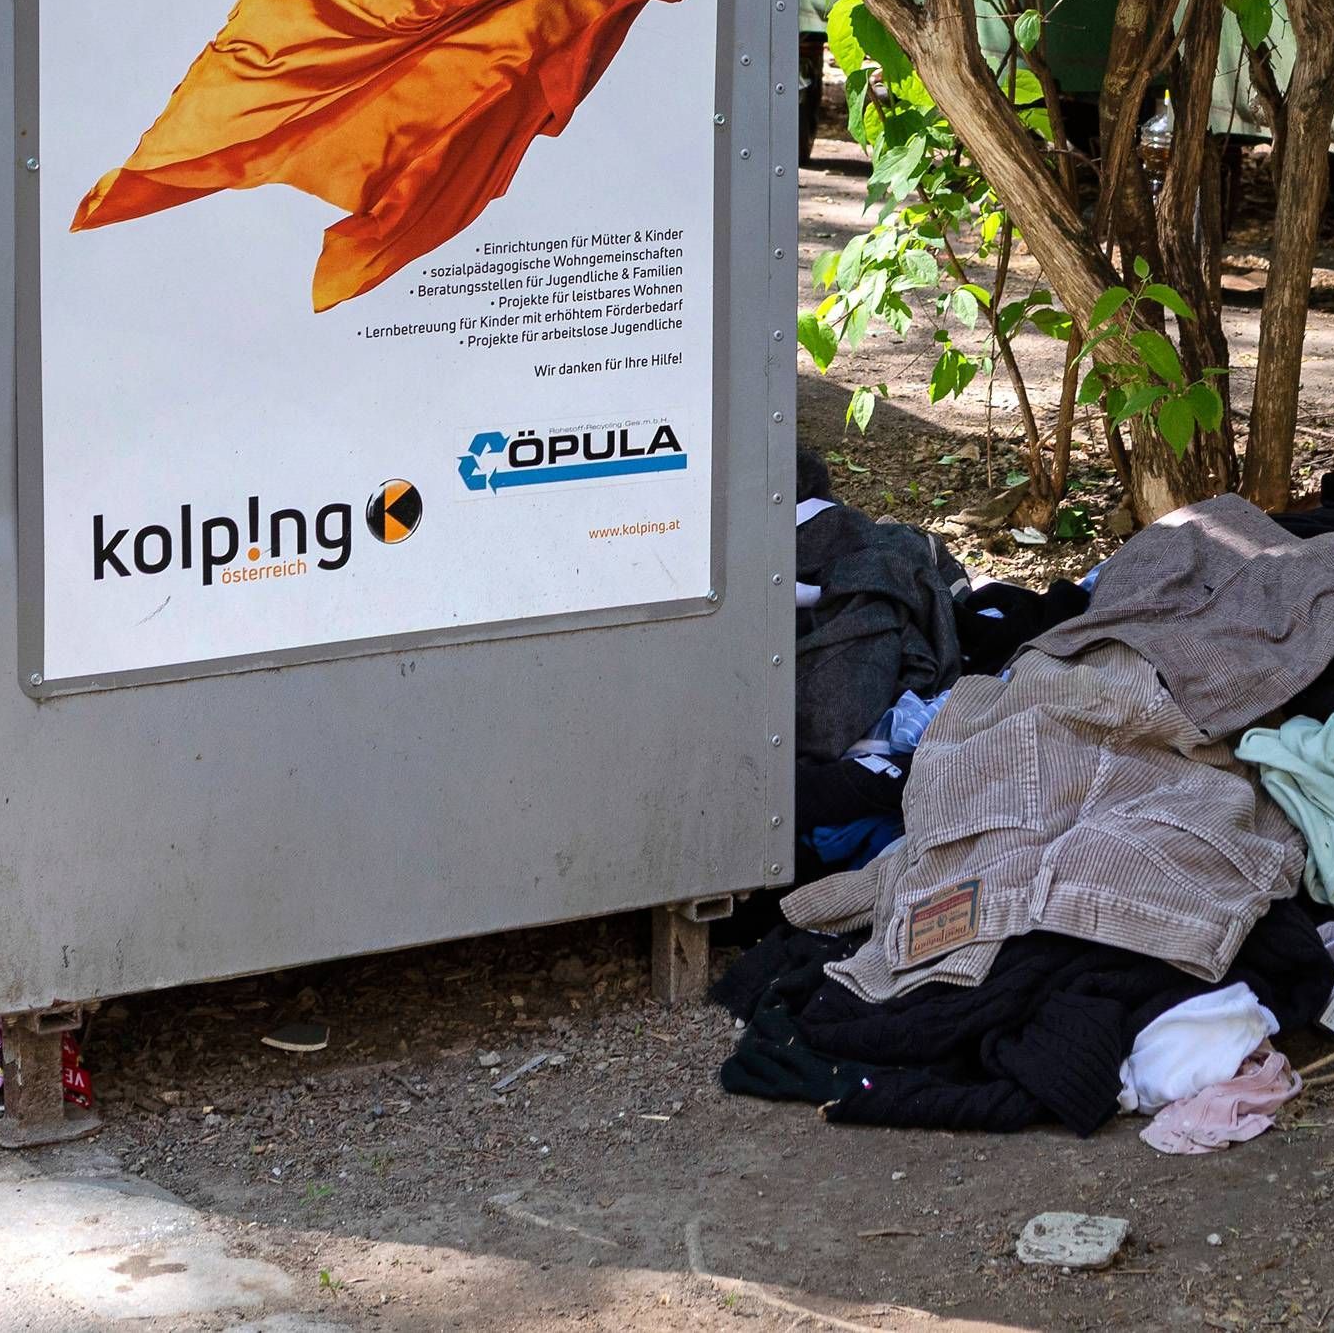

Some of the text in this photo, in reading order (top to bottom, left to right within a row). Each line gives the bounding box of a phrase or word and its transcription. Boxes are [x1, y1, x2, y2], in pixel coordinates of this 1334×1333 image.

[484, 228, 684, 255] Einrichtungen für Mütter & Kinder
[431, 246, 683, 278] sozialpädagogische Wohngemeinschaften
[418, 264, 683, 297] Beratungsstellen für Jugendliche & Familien
[499, 283, 683, 310] Projekte für leistbares Wohnen
[365, 298, 683, 338] Lernbetreuung für Kinder mit erhöhtem Förderbedarf
[468, 318, 683, 349] Projekte für arbeitslose Jugendliche
[534, 352, 682, 377] Wir danken für Ihre Hilfe!
[507, 424, 683, 469] ÖPULA
[588, 518, 681, 541] www.kolping.at
[221, 559, 307, 585] österreich
